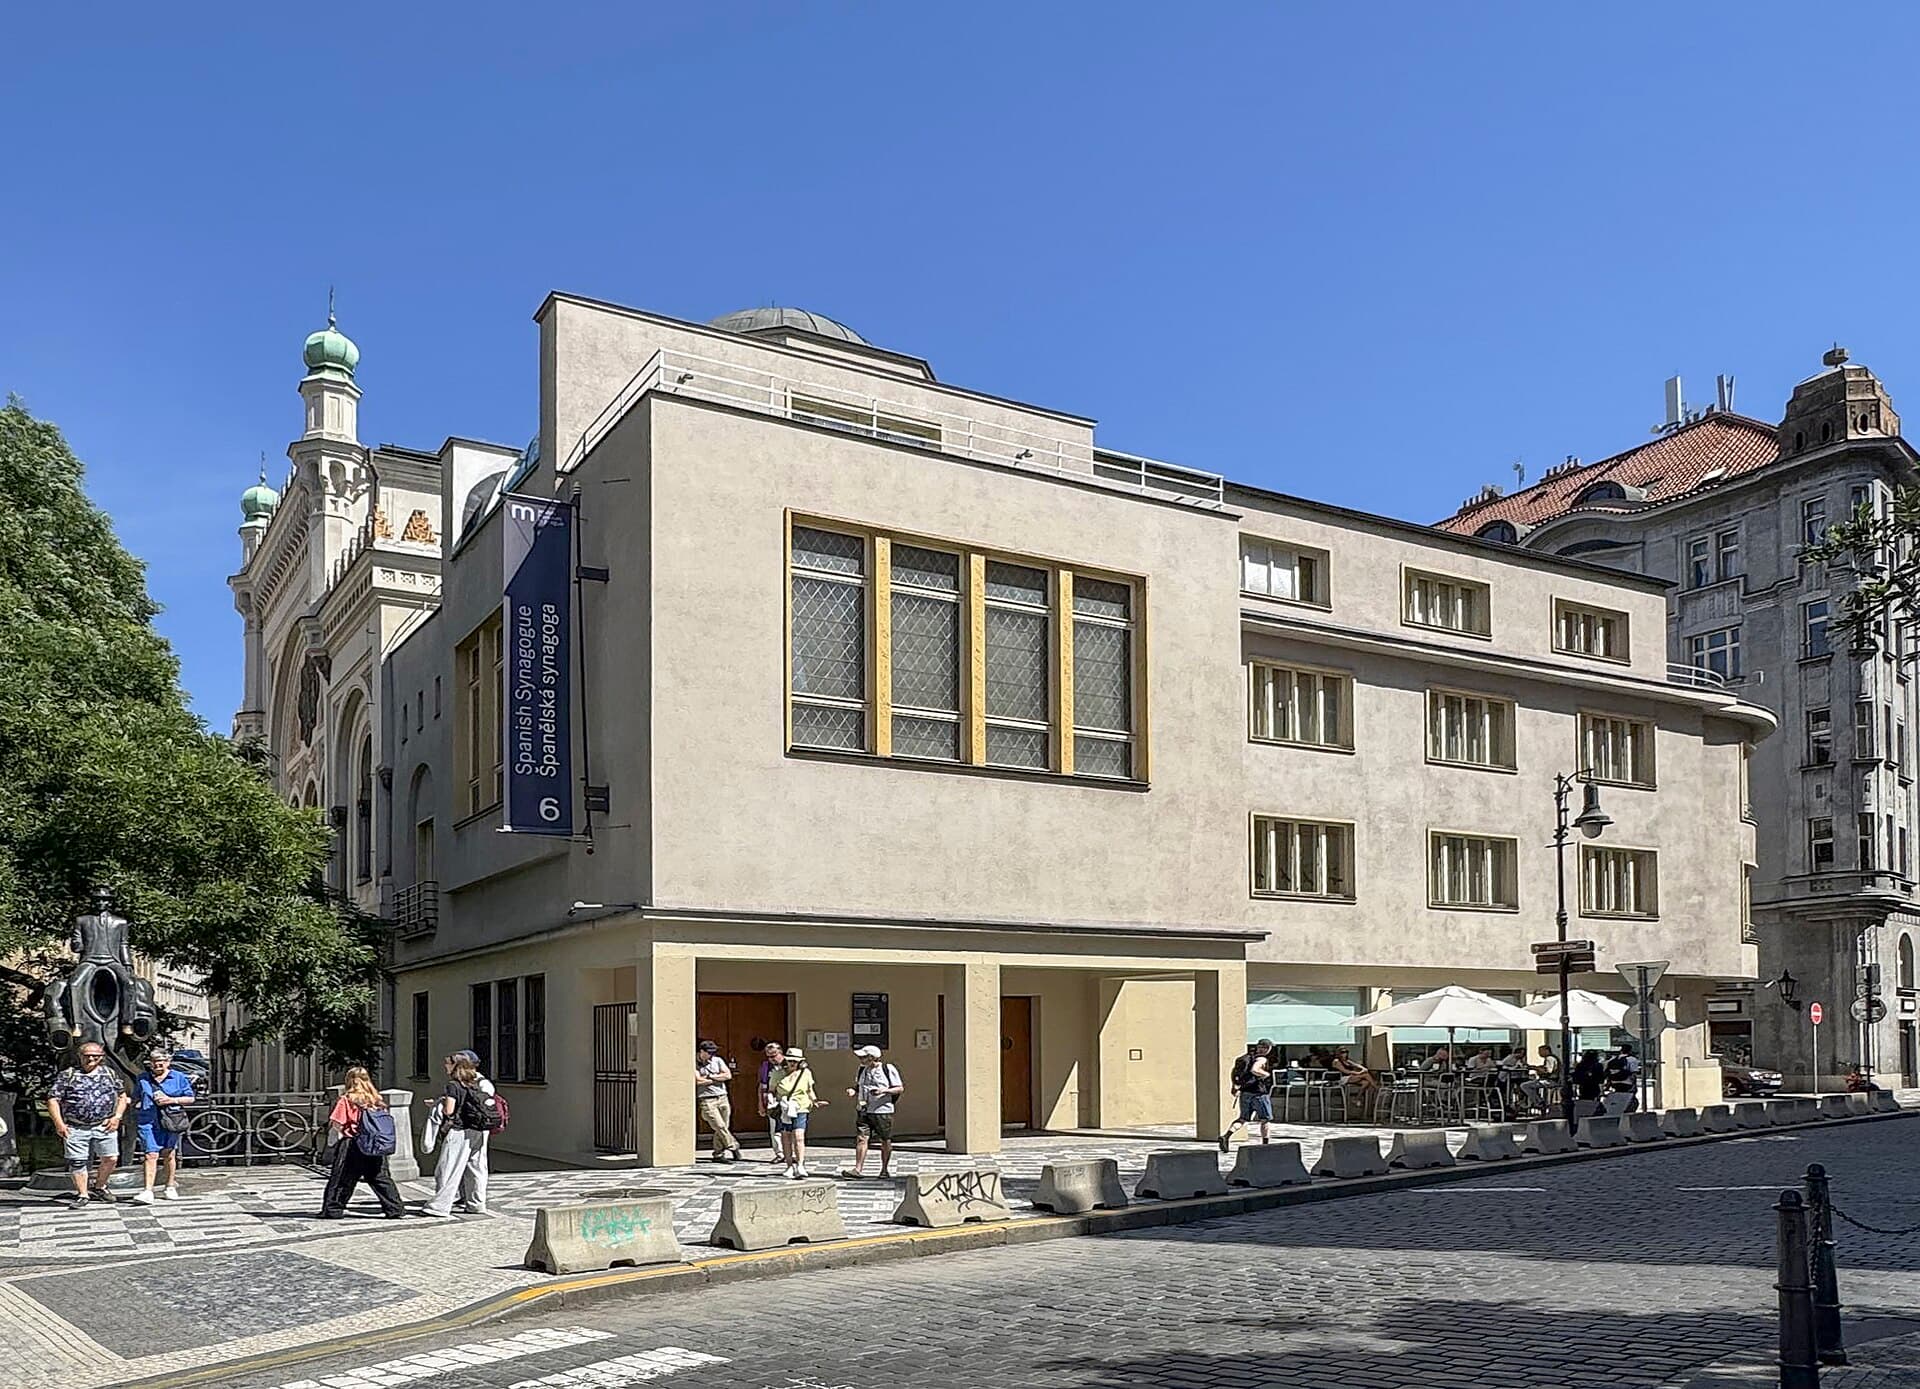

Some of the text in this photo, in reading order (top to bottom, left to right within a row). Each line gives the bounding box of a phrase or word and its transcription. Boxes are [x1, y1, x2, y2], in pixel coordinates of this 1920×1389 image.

[514, 605, 537, 775] Spanish Synagogue
[534, 604, 561, 777] Španělská synagoga
[540, 797, 560, 822] 6
